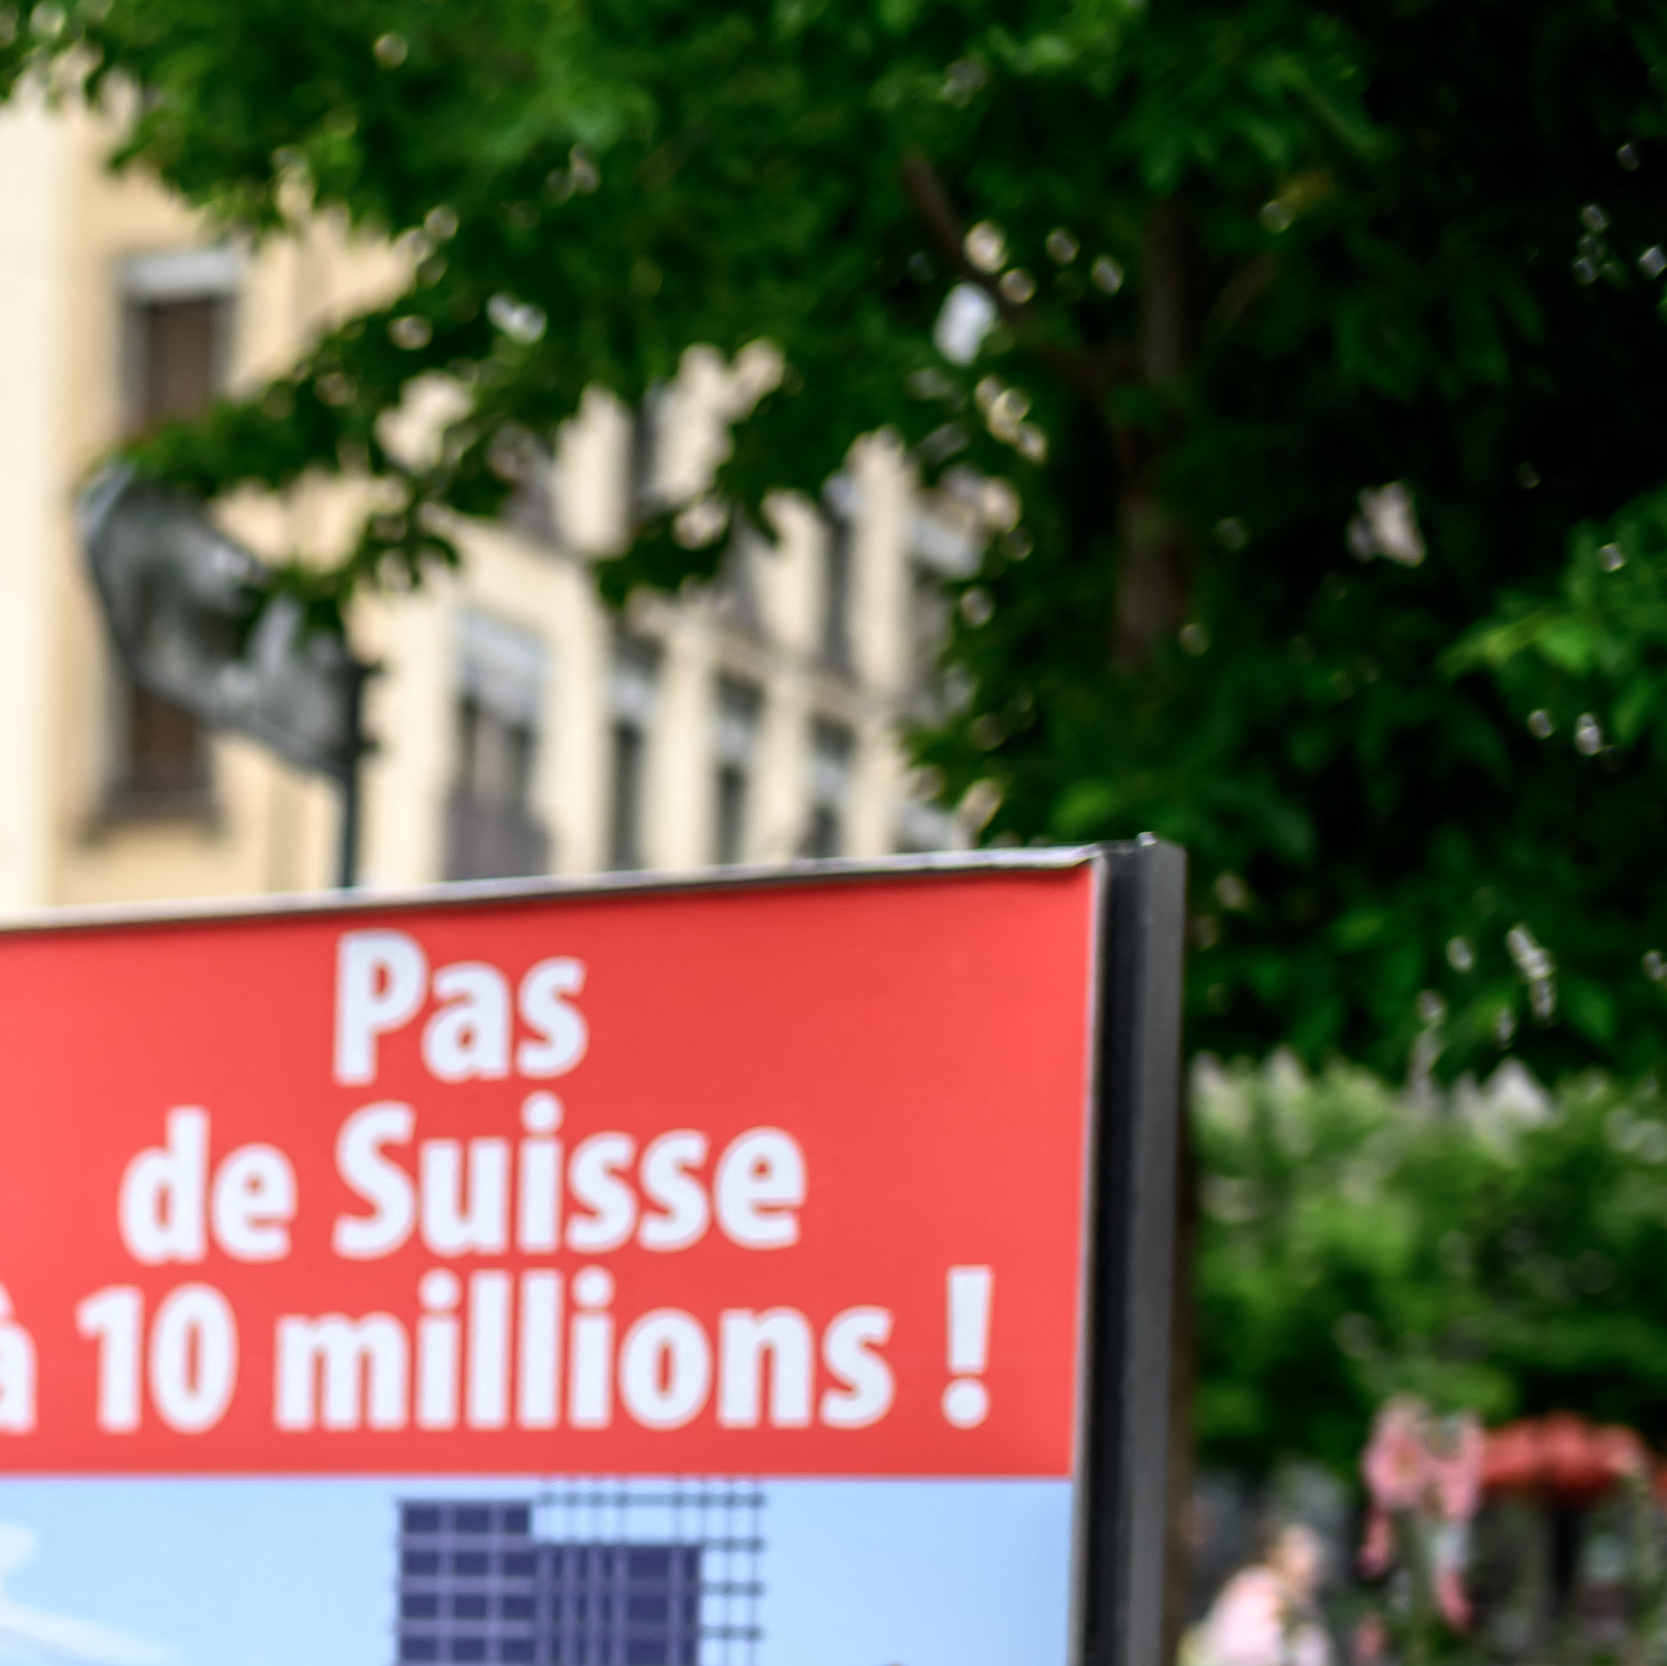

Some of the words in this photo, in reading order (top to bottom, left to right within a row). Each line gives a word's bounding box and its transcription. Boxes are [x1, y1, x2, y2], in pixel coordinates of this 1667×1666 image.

[332, 928, 589, 1086] Pas
[118, 1106, 296, 1264] de
[332, 1090, 807, 1258] Suisse
[76, 1284, 237, 1434] 10
[274, 1264, 895, 1432] millions
[941, 1263, 995, 1431] !
